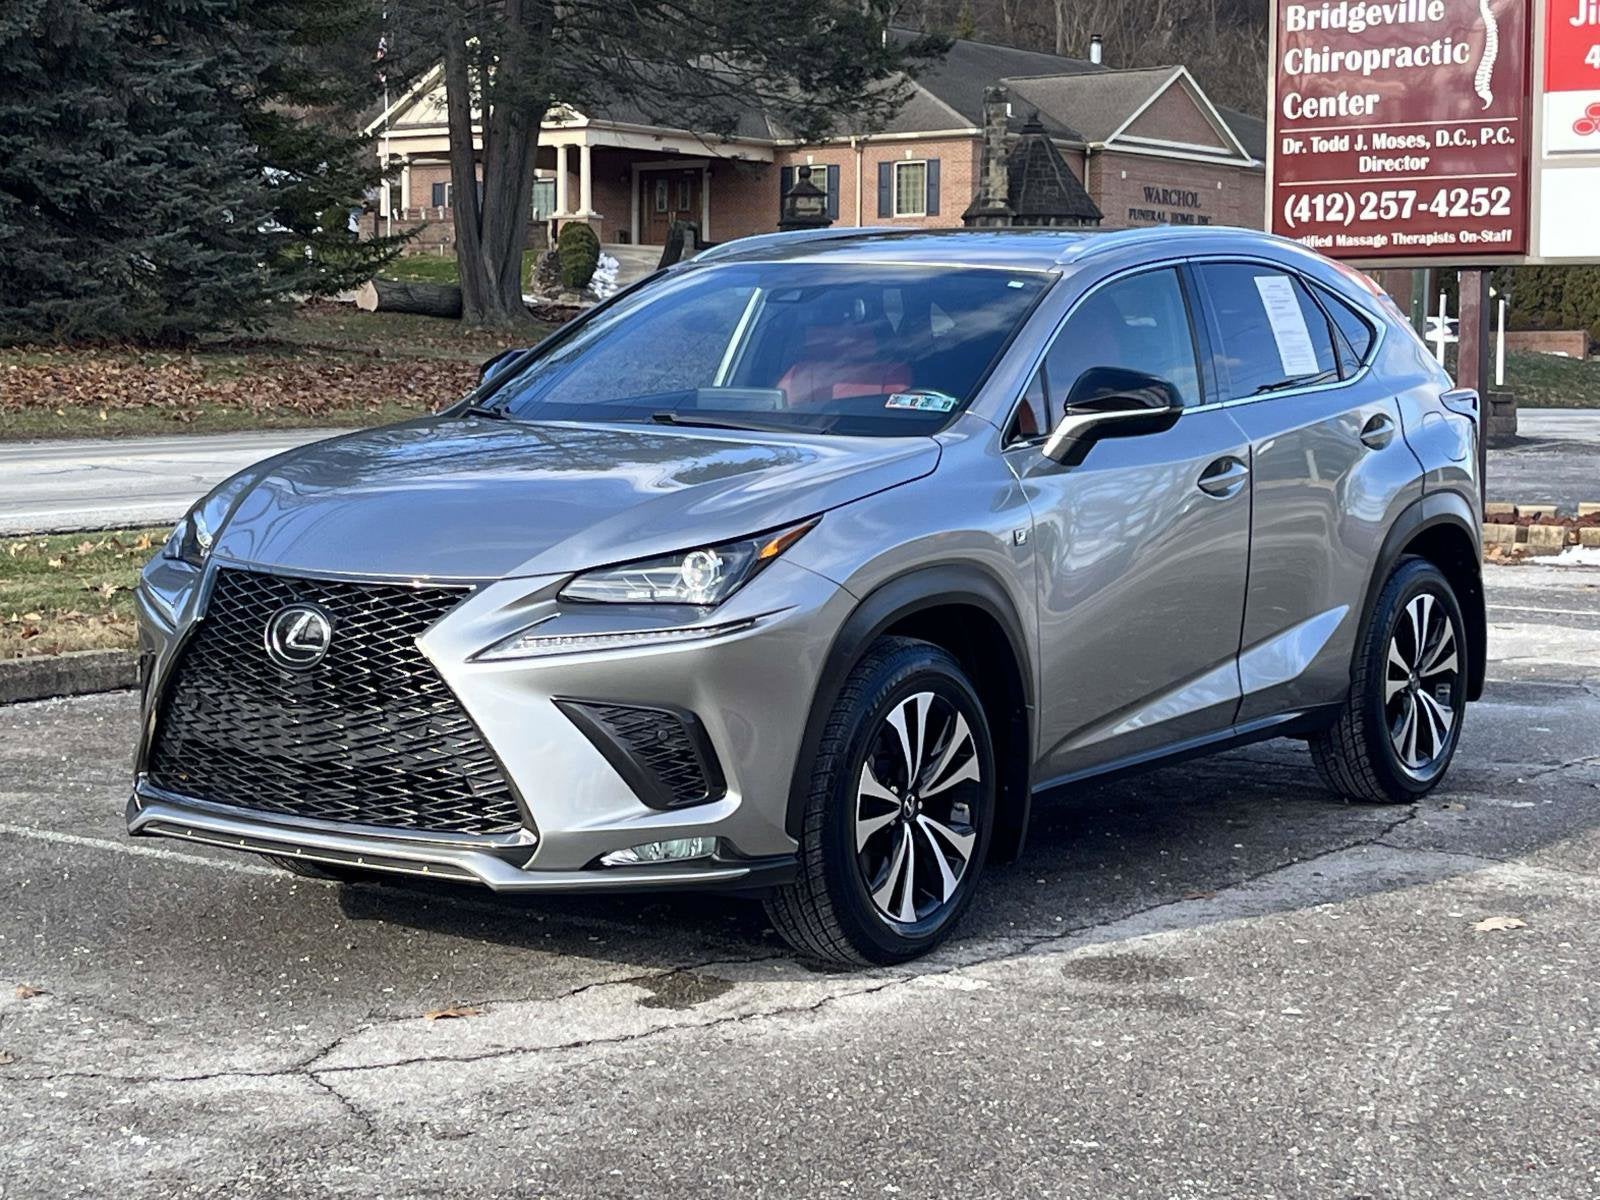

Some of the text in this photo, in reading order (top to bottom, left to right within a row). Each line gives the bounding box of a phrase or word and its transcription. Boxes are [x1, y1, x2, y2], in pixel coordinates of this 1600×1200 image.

[1286, 0, 1445, 33] Bridgeville
[1284, 37, 1470, 76] Chiropractic
[1282, 91, 1380, 120] Center
[1282, 126, 1515, 155] Dr. Todd J. Moses, D.C., P.C.
[1359, 155, 1430, 173] Director
[1143, 186, 1202, 208] WARCHOL
[1128, 208, 1168, 223] FUNERAL
[1335, 234, 1389, 248] Massage
[1390, 231, 1457, 247] Therapists
[1459, 229, 1513, 243] On-Staff
